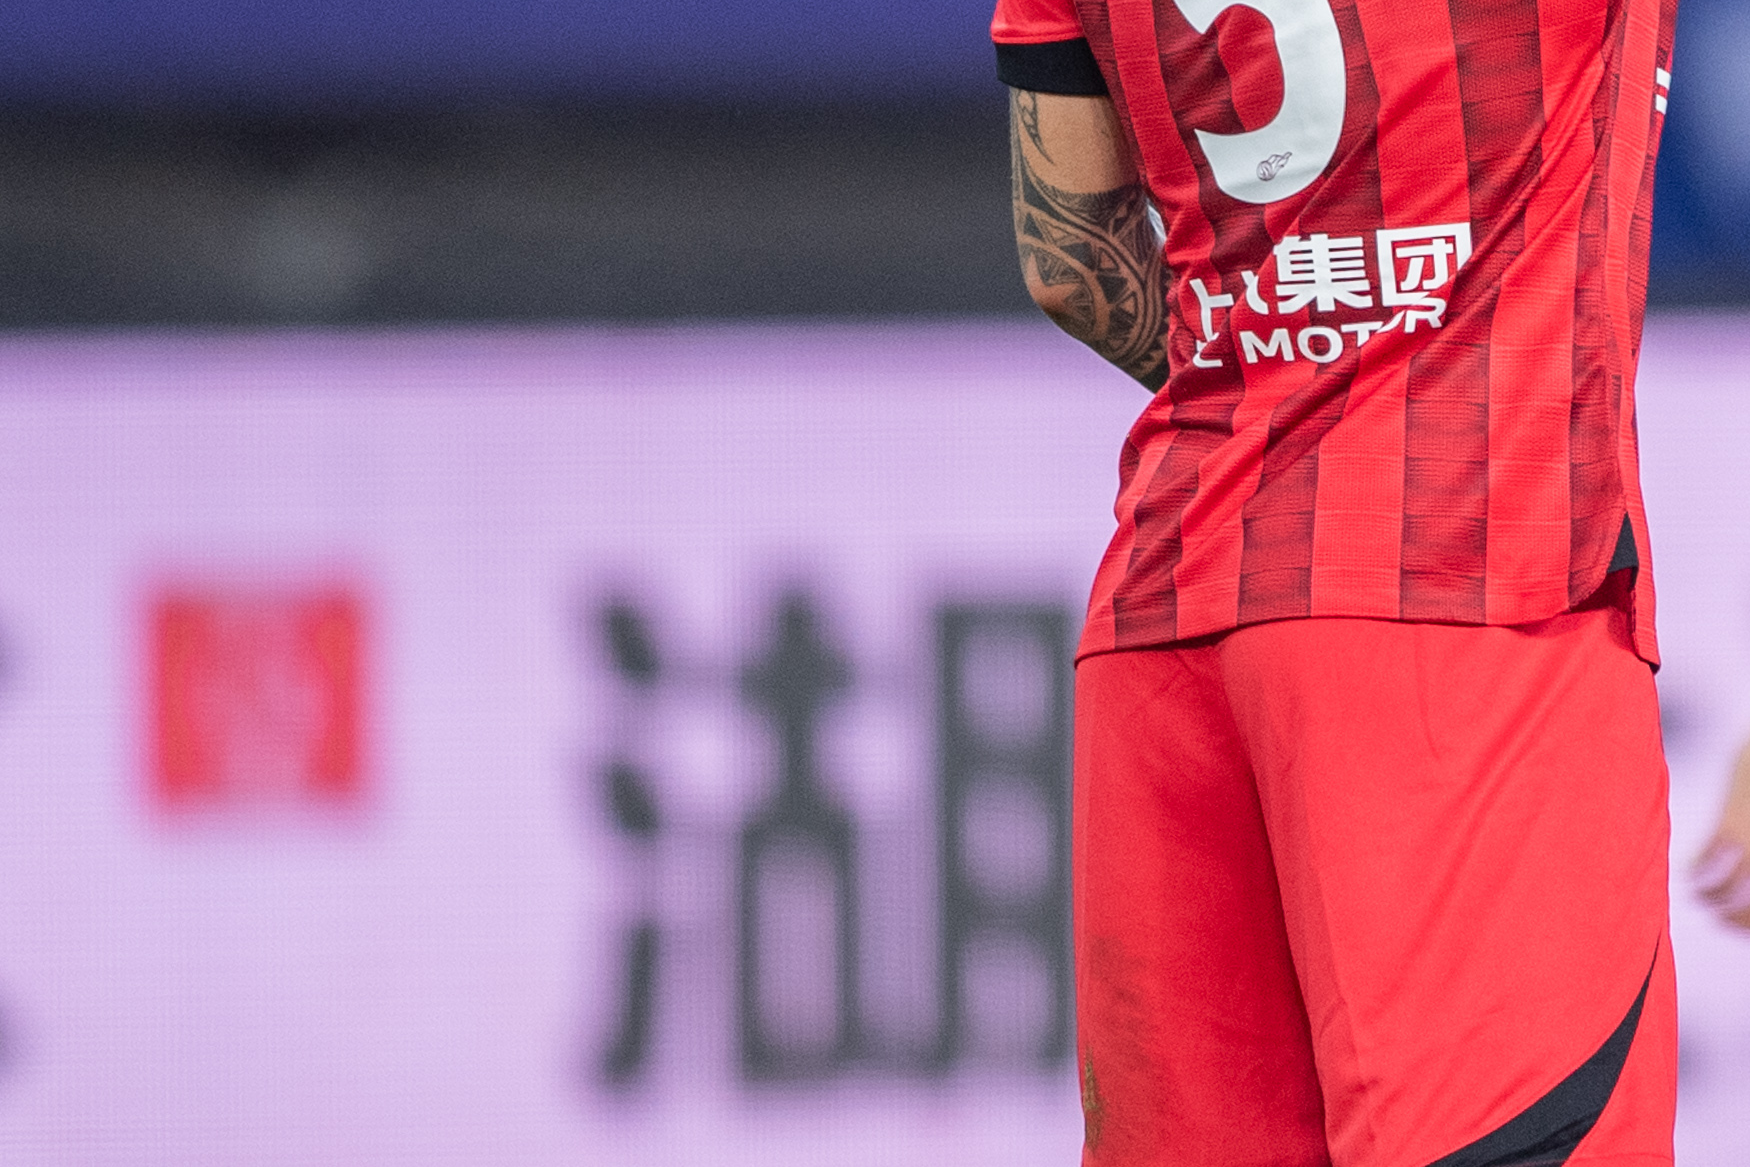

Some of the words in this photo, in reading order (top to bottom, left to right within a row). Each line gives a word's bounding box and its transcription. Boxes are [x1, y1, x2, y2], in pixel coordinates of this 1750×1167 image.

[1188, 221, 1472, 341] 上集团
[1238, 296, 1447, 365] MOTR
